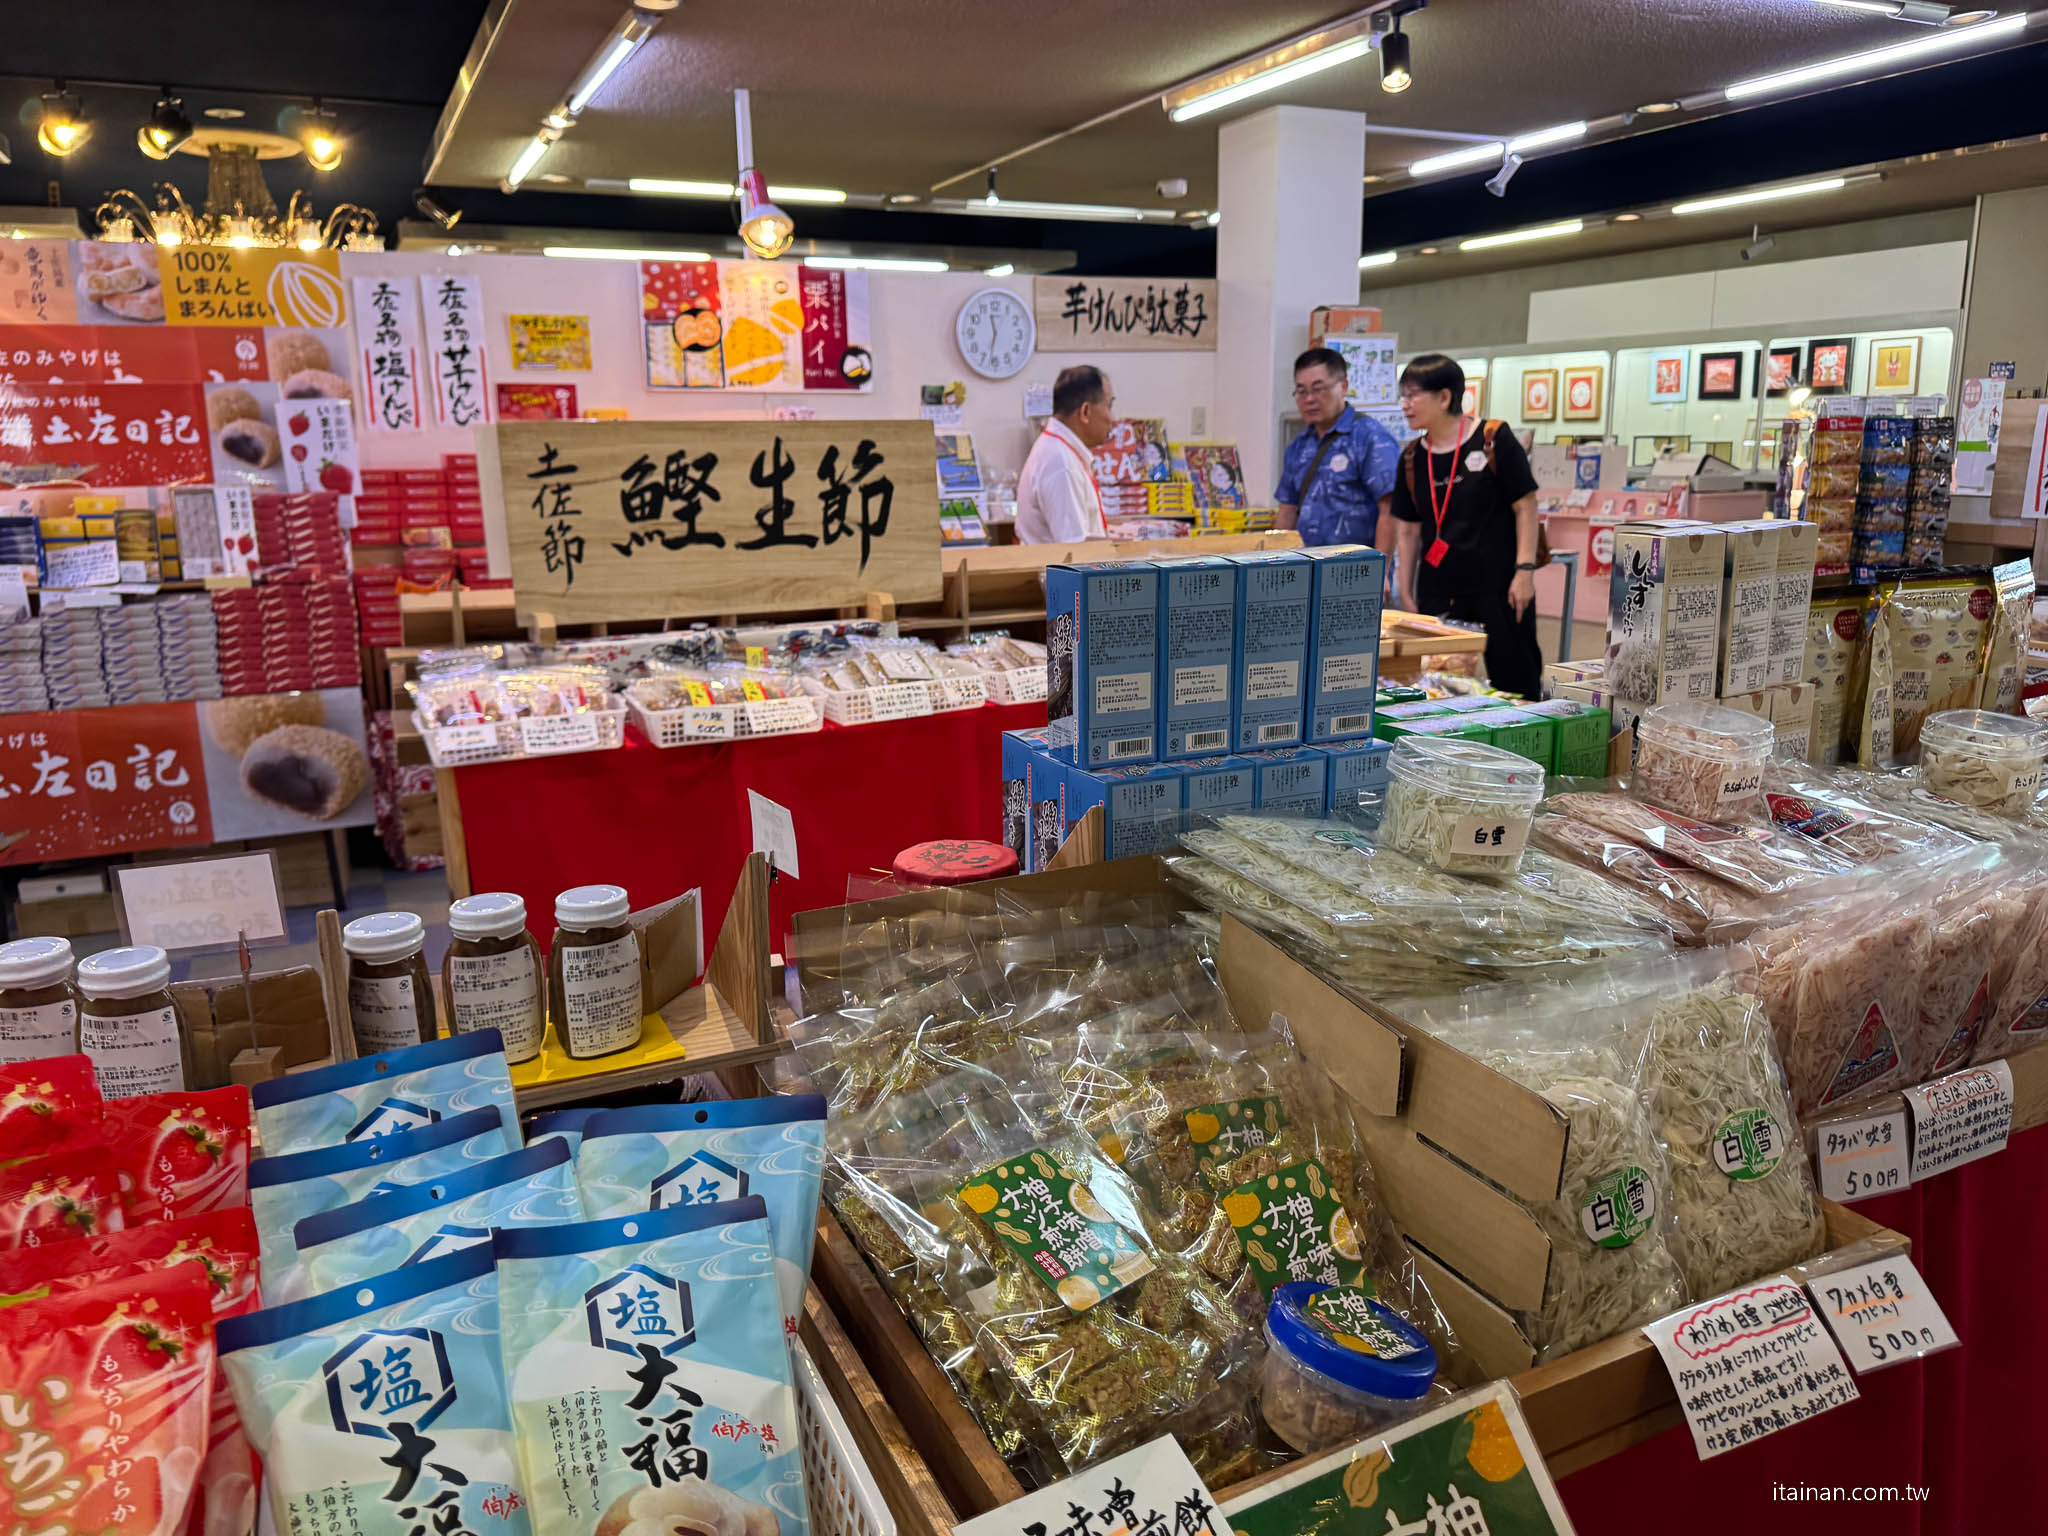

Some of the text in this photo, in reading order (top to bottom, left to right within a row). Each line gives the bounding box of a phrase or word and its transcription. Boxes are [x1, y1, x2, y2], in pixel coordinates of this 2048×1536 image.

[173, 252, 232, 273] 100%
[176, 277, 250, 296] しまんと
[803, 280, 831, 364] 栗パイ
[527, 442, 585, 597] 土佐節
[611, 436, 894, 578] 鰹生節
[1629, 549, 1655, 609] しらす
[1723, 1120, 1771, 1163] 白雪
[1019, 1176, 1105, 1251] 柚子味噌
[1591, 1178, 1644, 1231] 白雪
[1845, 1168, 1898, 1195] 500円
[1001, 1187, 1091, 1272] ナッツ煎餅
[607, 1285, 677, 1339] 塩
[1689, 1316, 1735, 1346] わかめ
[1736, 1304, 1762, 1328] 白雪
[1868, 1327, 1934, 1360] 500円
[351, 1346, 433, 1416] 塩
[101, 1355, 137, 1523] もっちりやわらか
[561, 1397, 581, 1477] もっちりとした
[621, 1342, 708, 1489] 大福
